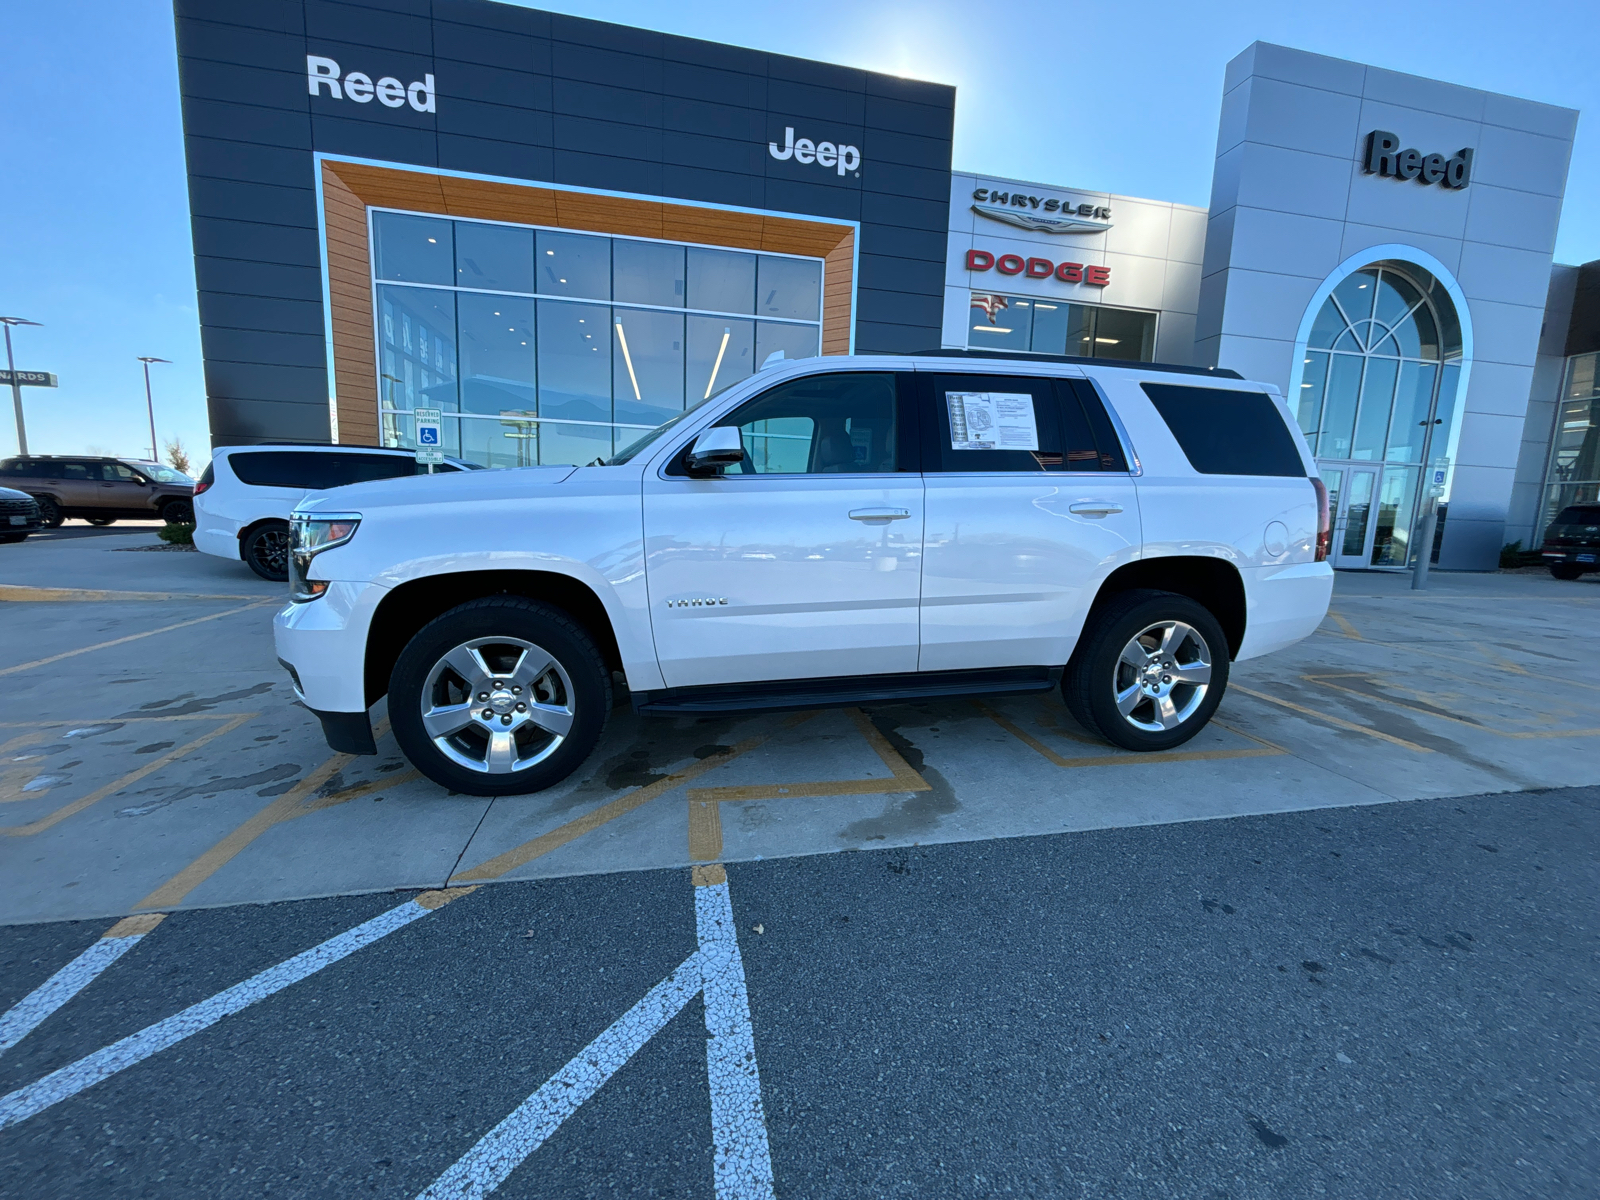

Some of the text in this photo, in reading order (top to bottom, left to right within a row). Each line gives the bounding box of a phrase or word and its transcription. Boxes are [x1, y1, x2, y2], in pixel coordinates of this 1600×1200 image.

[306, 54, 436, 114] Reed
[768, 126, 860, 177] Jeep
[1364, 129, 1474, 190] Reed
[972, 188, 1112, 219] CHRYSLER
[966, 249, 1112, 287] DODGE
[665, 597, 728, 608] TAHOE
